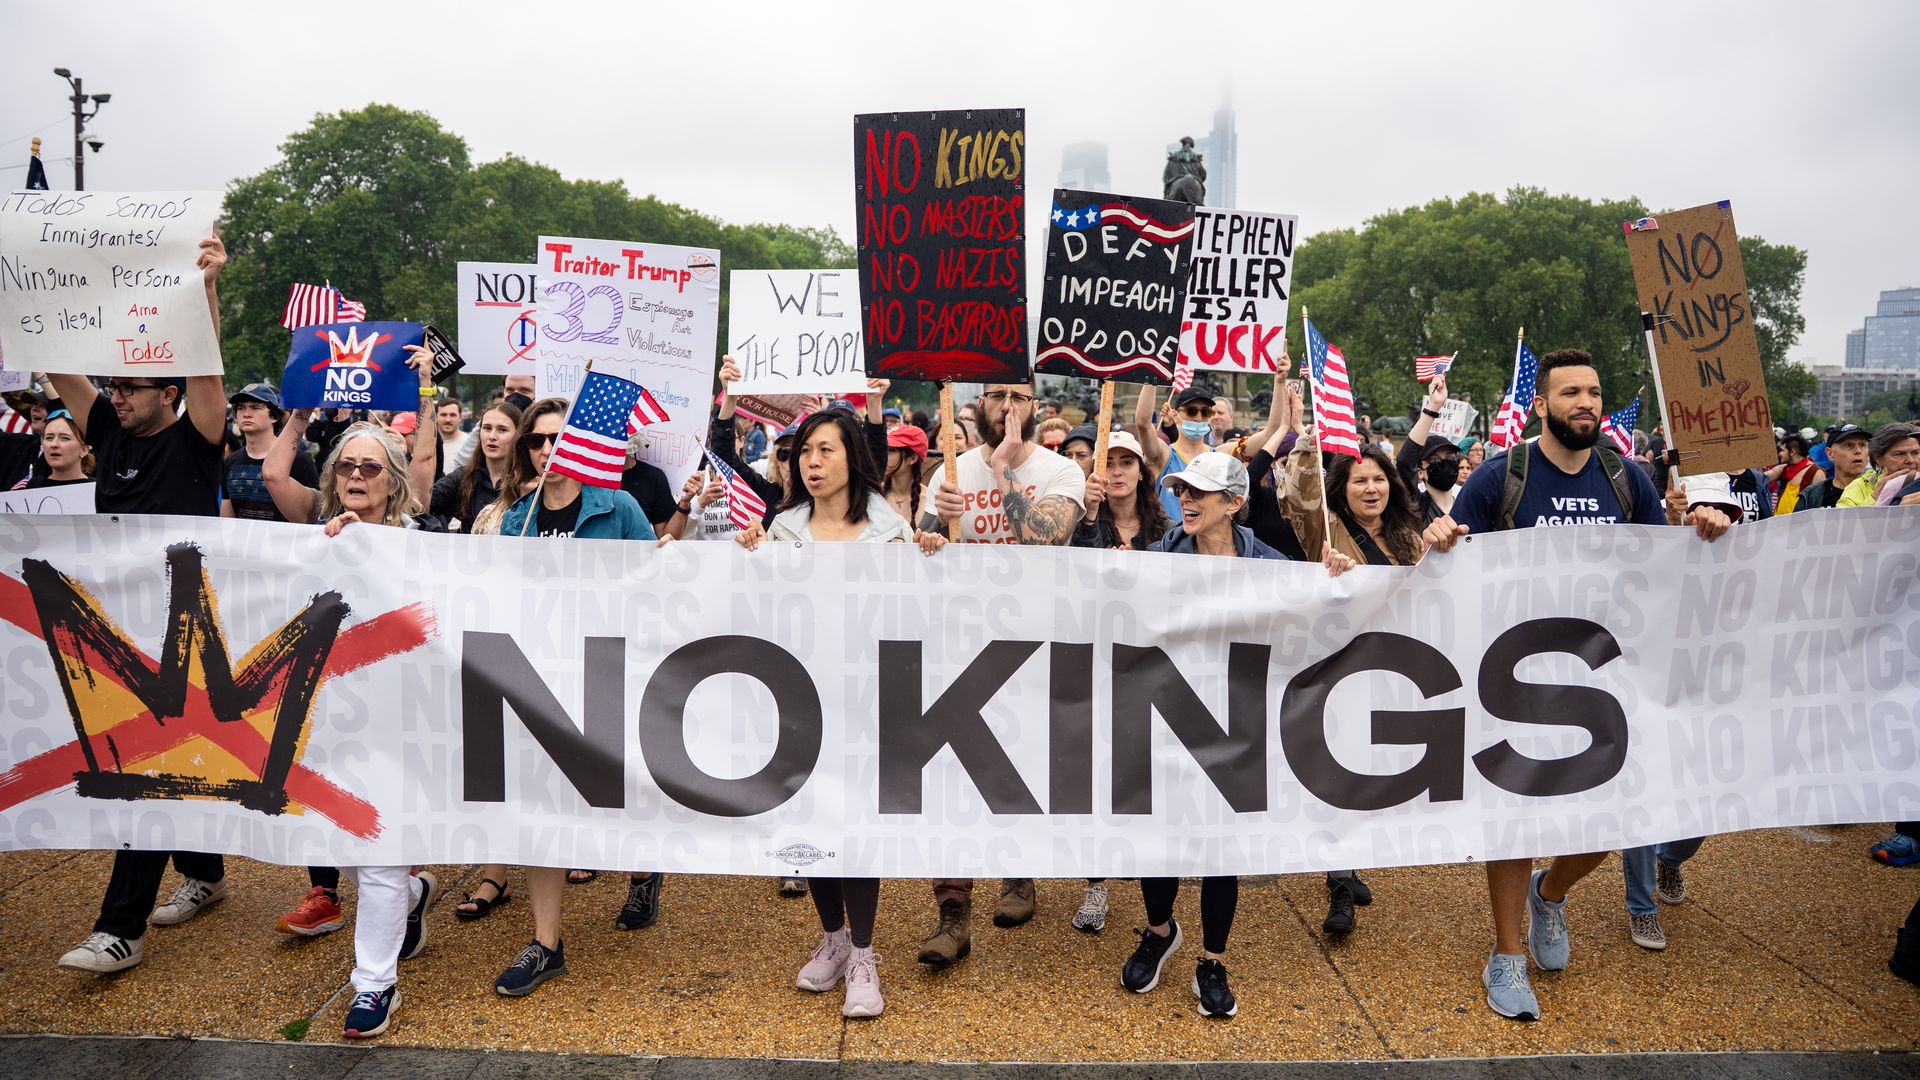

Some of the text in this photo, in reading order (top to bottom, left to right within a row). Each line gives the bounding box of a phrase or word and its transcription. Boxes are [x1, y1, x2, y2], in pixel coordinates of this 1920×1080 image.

[865, 127, 921, 199] NO
[40, 222, 165, 248] Inmigrantes!
[864, 203, 911, 249] NO
[1195, 212, 1294, 257] TEPHEN
[545, 243, 621, 277] Traitor
[621, 249, 692, 293] Trump
[1064, 225, 1180, 274] DEFY
[1658, 232, 1723, 286] NO
[1, 255, 89, 292] Ninguna
[871, 252, 921, 293] NO
[127, 304, 160, 316] Ama
[542, 281, 624, 345] 32
[628, 292, 694, 322] Espionage
[768, 272, 844, 318] WE
[1060, 275, 1174, 315] IMPEACH
[1189, 297, 1258, 322] IS A
[20, 306, 102, 335] es ilegal
[139, 324, 148, 334] a
[671, 321, 692, 335] Act
[868, 299, 906, 346] NO
[1043, 317, 1176, 364] OPPOSE
[117, 338, 174, 360] Todos
[626, 327, 693, 360] Violations
[737, 330, 865, 382] THE PEOPL
[325, 368, 372, 391] NO
[1697, 356, 1727, 388] IN
[323, 390, 372, 403] KINGS
[761, 406, 793, 424] HOUSE
[1534, 515, 1617, 528] AGAINST
[1551, 497, 1600, 511] VETS
[706, 524, 719, 533] FOR
[1786, 507, 1920, 551] KING
[1675, 569, 1757, 639] NO
[1774, 552, 1920, 624] KING
[1664, 641, 1746, 708] NO
[461, 630, 823, 818] NO
[878, 616, 1629, 815] KINGS
[1667, 714, 1745, 790] NO
[1769, 700, 1920, 778] KING
[1774, 782, 1920, 826] KING
